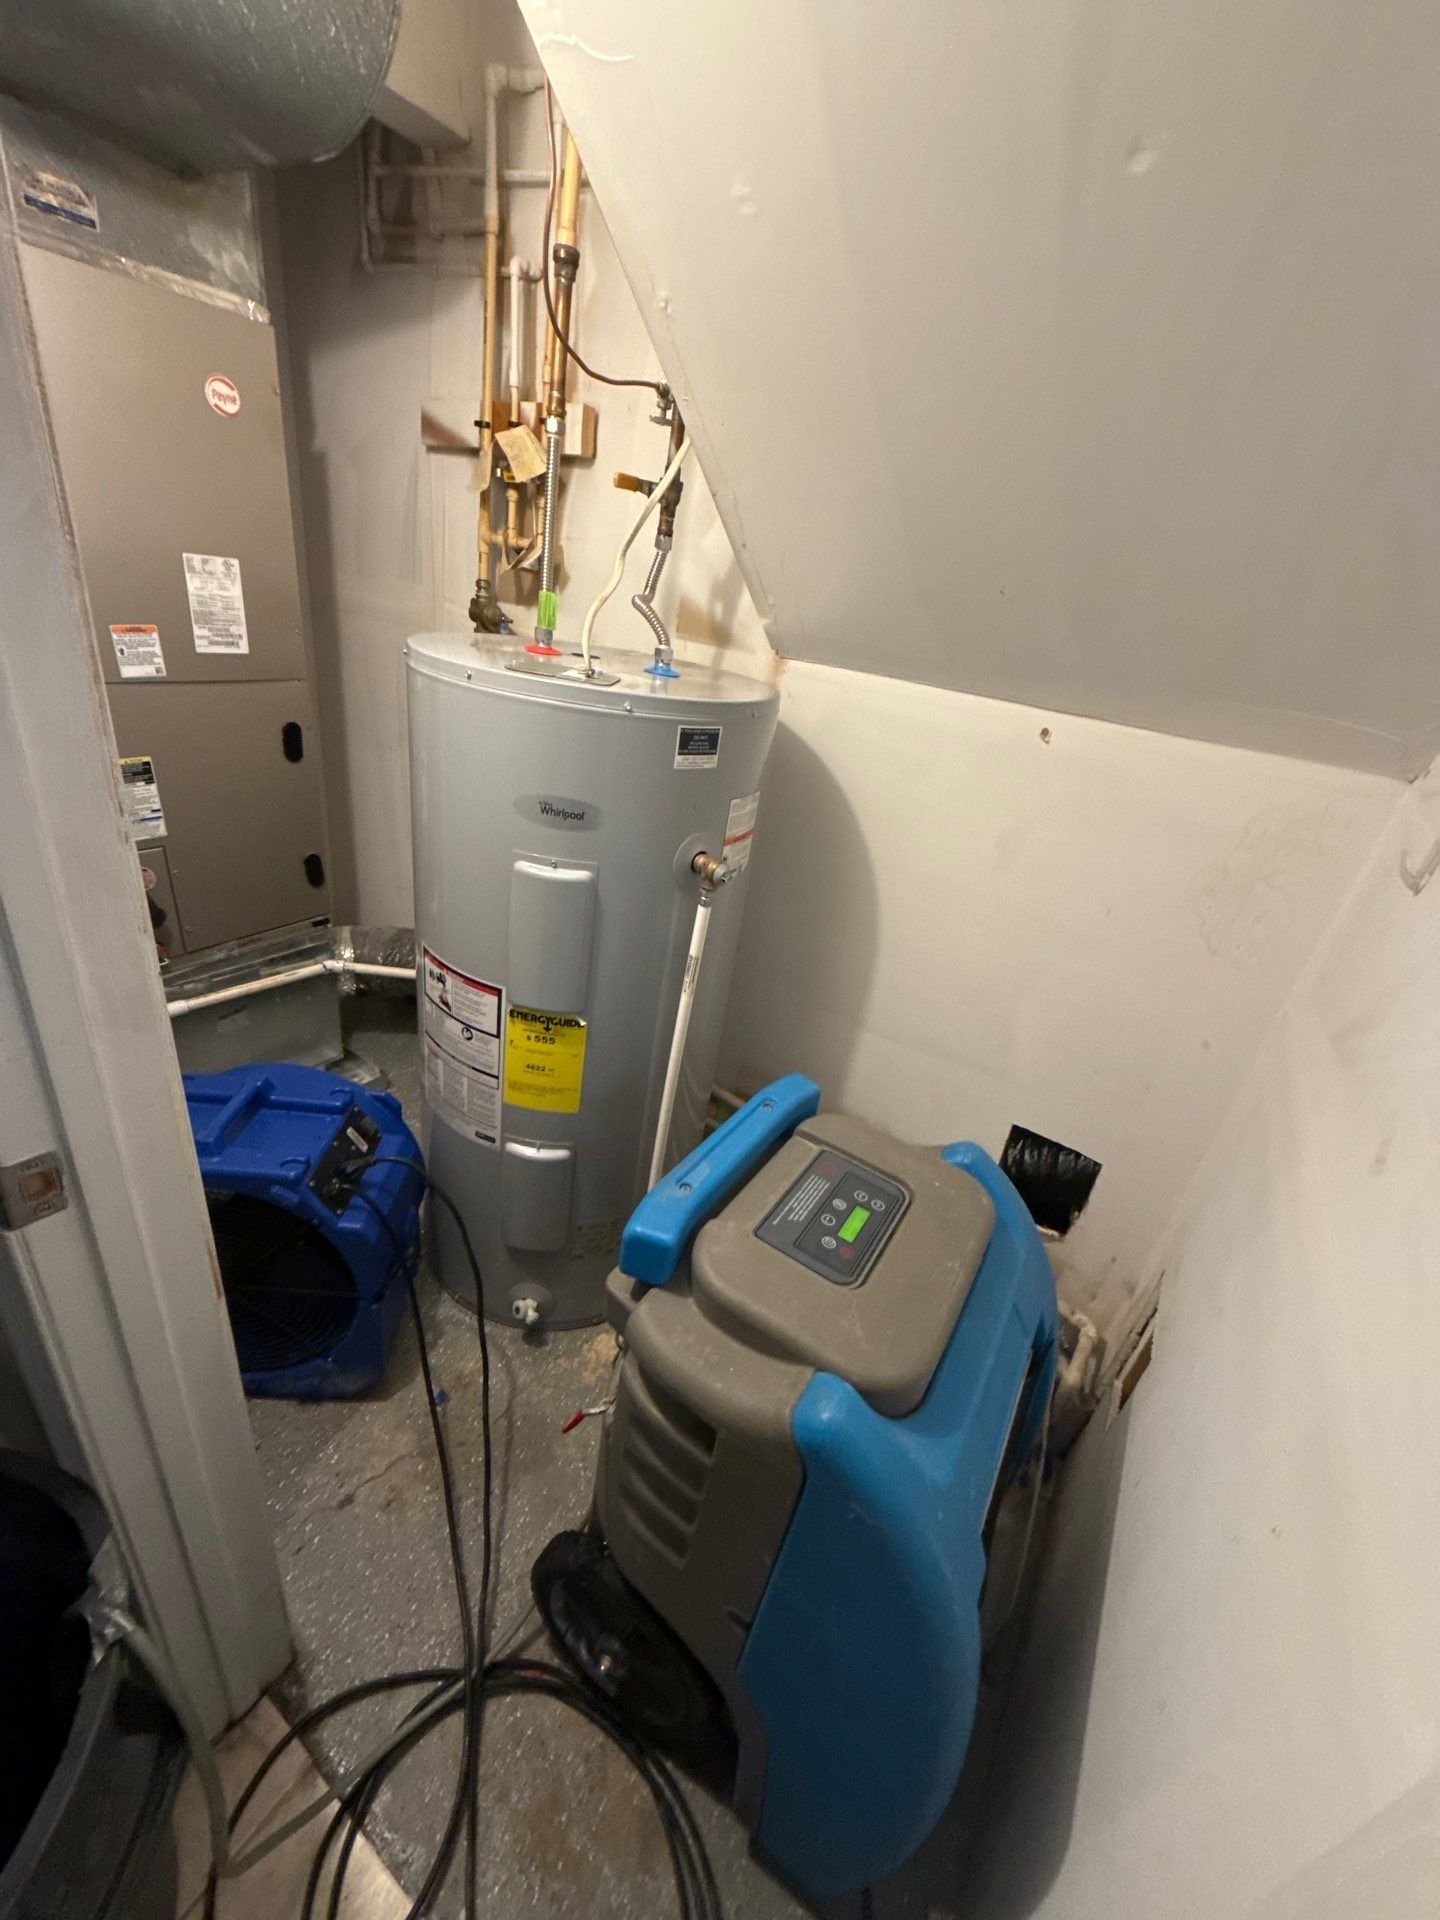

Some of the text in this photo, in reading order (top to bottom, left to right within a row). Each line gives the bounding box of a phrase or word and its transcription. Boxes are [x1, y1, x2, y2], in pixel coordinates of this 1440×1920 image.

[211, 388, 237, 405] Payne
[540, 804, 585, 821] Whirlpool
[534, 1035, 557, 1045] 555
